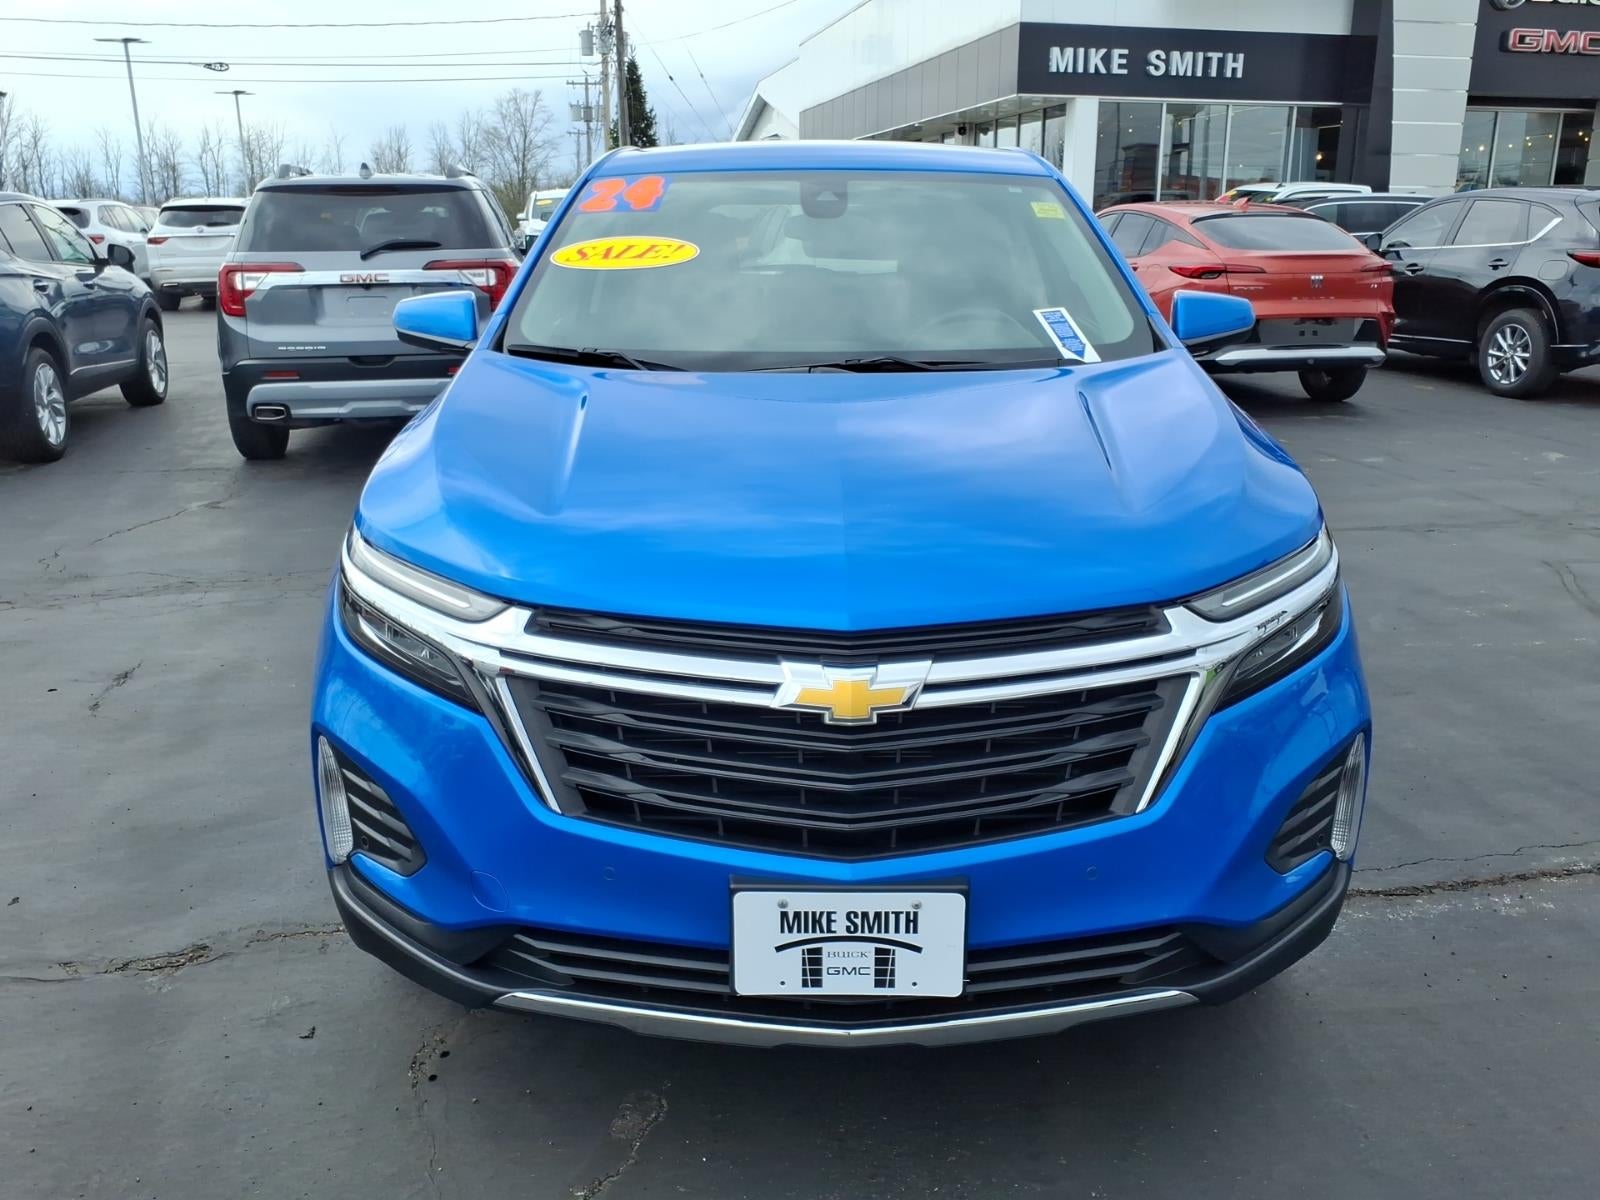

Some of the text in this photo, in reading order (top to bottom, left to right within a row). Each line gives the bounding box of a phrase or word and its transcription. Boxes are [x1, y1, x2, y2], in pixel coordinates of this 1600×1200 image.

[1508, 27, 1600, 55] GMC
[1049, 46, 1245, 79] MIKE SMITH
[579, 175, 666, 212] 24
[565, 244, 686, 262] SALE!
[339, 273, 390, 283] GMC
[780, 910, 919, 935] MIKE SMITH
[826, 966, 871, 976] GMC
